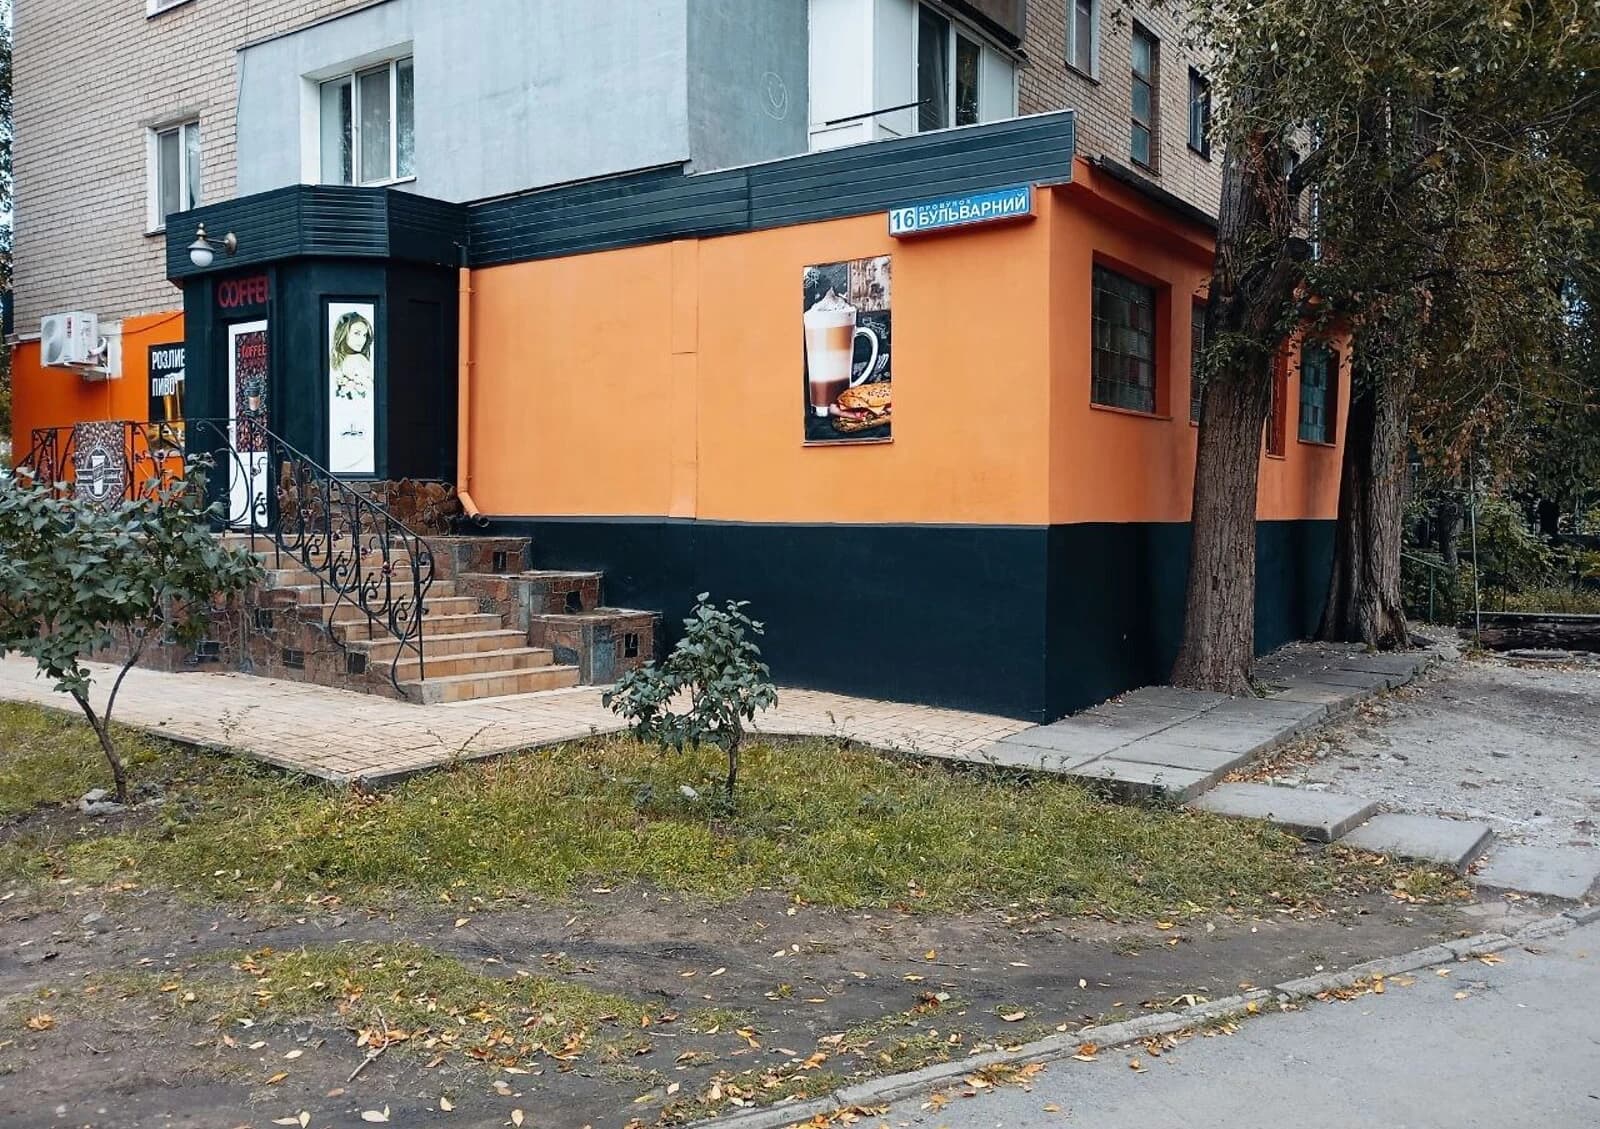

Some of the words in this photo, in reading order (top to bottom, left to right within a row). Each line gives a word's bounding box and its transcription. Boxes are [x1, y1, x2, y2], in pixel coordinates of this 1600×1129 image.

[919, 193, 1026, 225] БУЛЬВАРНИЙ
[892, 210, 914, 230] 16
[152, 376, 175, 397] ПИВО
